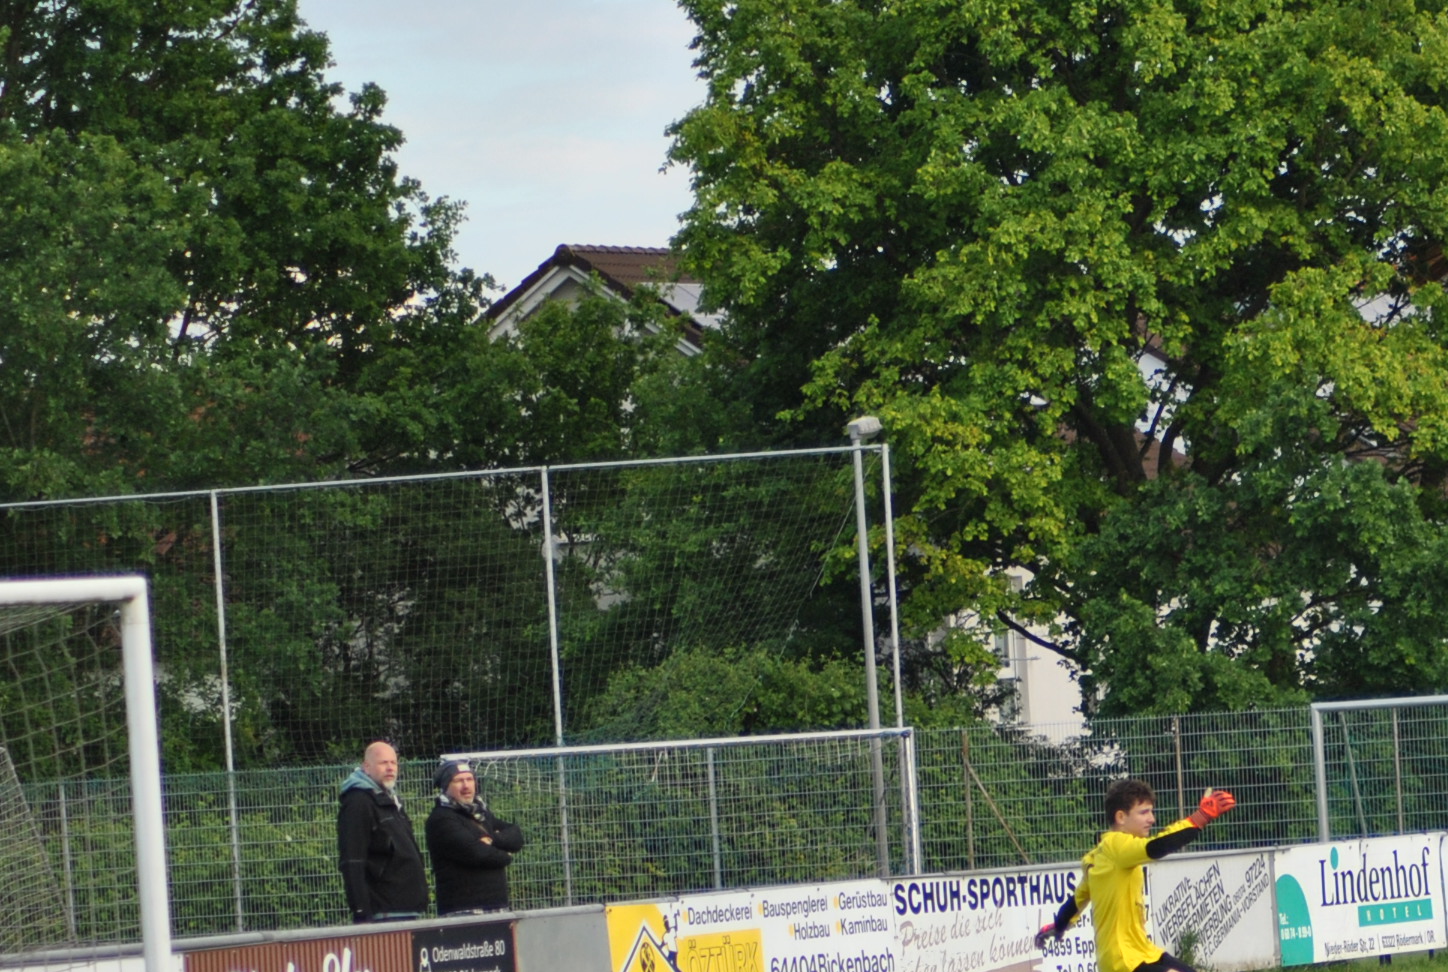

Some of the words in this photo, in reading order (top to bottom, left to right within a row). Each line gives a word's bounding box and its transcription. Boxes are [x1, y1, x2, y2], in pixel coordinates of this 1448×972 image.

[1244, 852, 1266, 889] 97224
[1319, 846, 1431, 907] Lindenhof
[688, 902, 752, 925] Dachdeckerei
[762, 895, 828, 918] Bauspenglerei
[838, 889, 888, 911] Gerüstbau
[1155, 877, 1192, 927] LUKRATIVE
[1366, 904, 1423, 922] HOTEL
[793, 922, 831, 940] Holzbau
[840, 915, 888, 936] Kaminbau
[900, 920, 947, 957] Preise
[951, 911, 970, 939] die
[975, 905, 1004, 934] sich
[432, 940, 494, 963] Odenwaldstraße
[494, 939, 506, 957] 80
[1042, 938, 1072, 958] 64859
